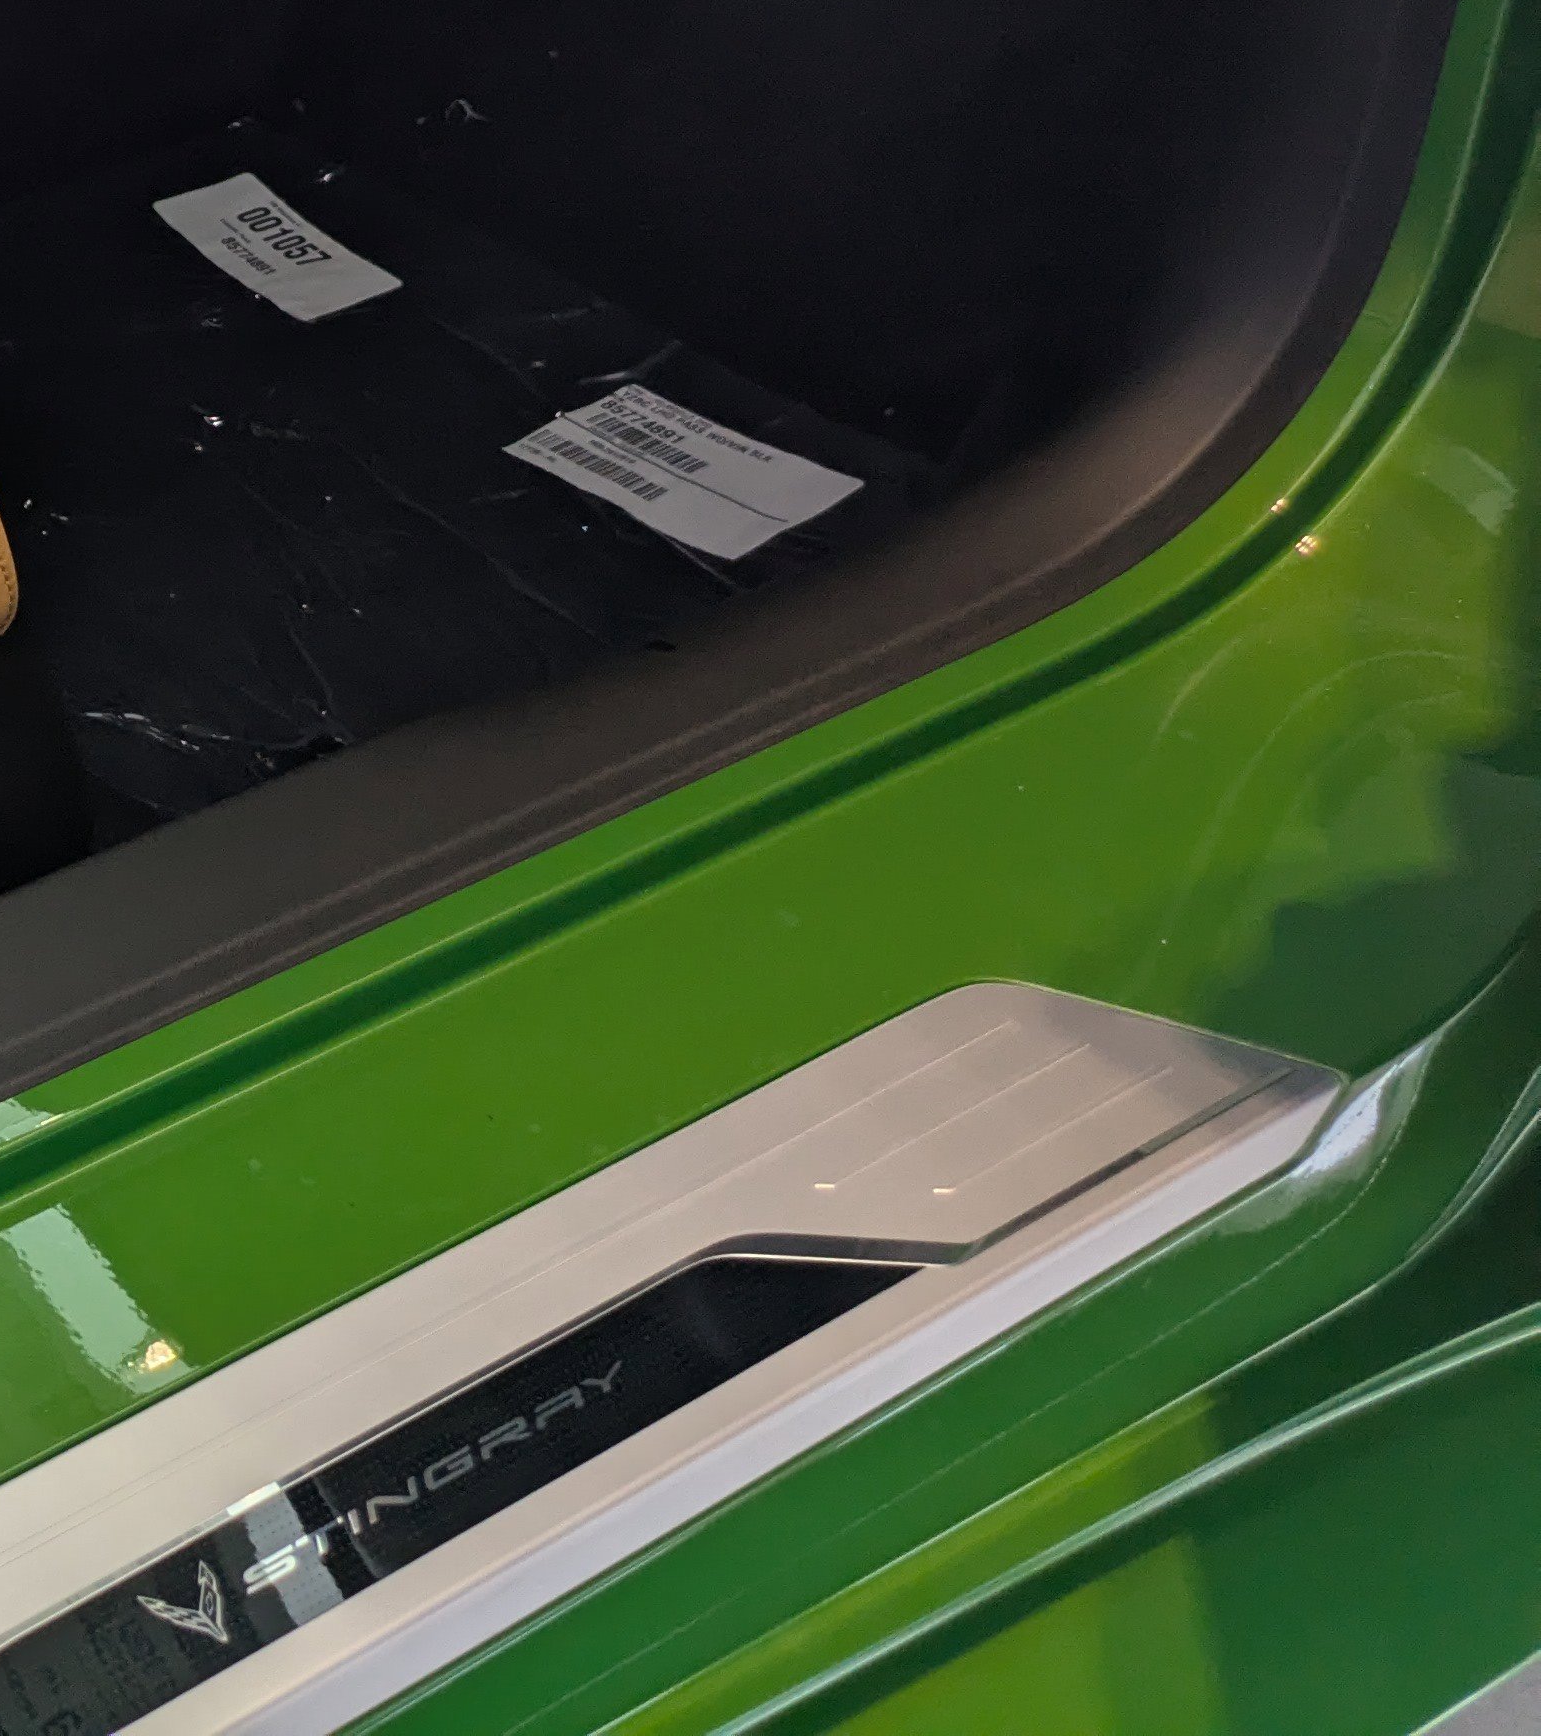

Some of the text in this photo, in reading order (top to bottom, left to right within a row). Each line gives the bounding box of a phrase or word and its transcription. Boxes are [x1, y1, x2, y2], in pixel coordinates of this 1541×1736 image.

[237, 206, 333, 266] 001057
[600, 399, 686, 445] 85774891
[242, 1360, 623, 1595] STINGRAY
